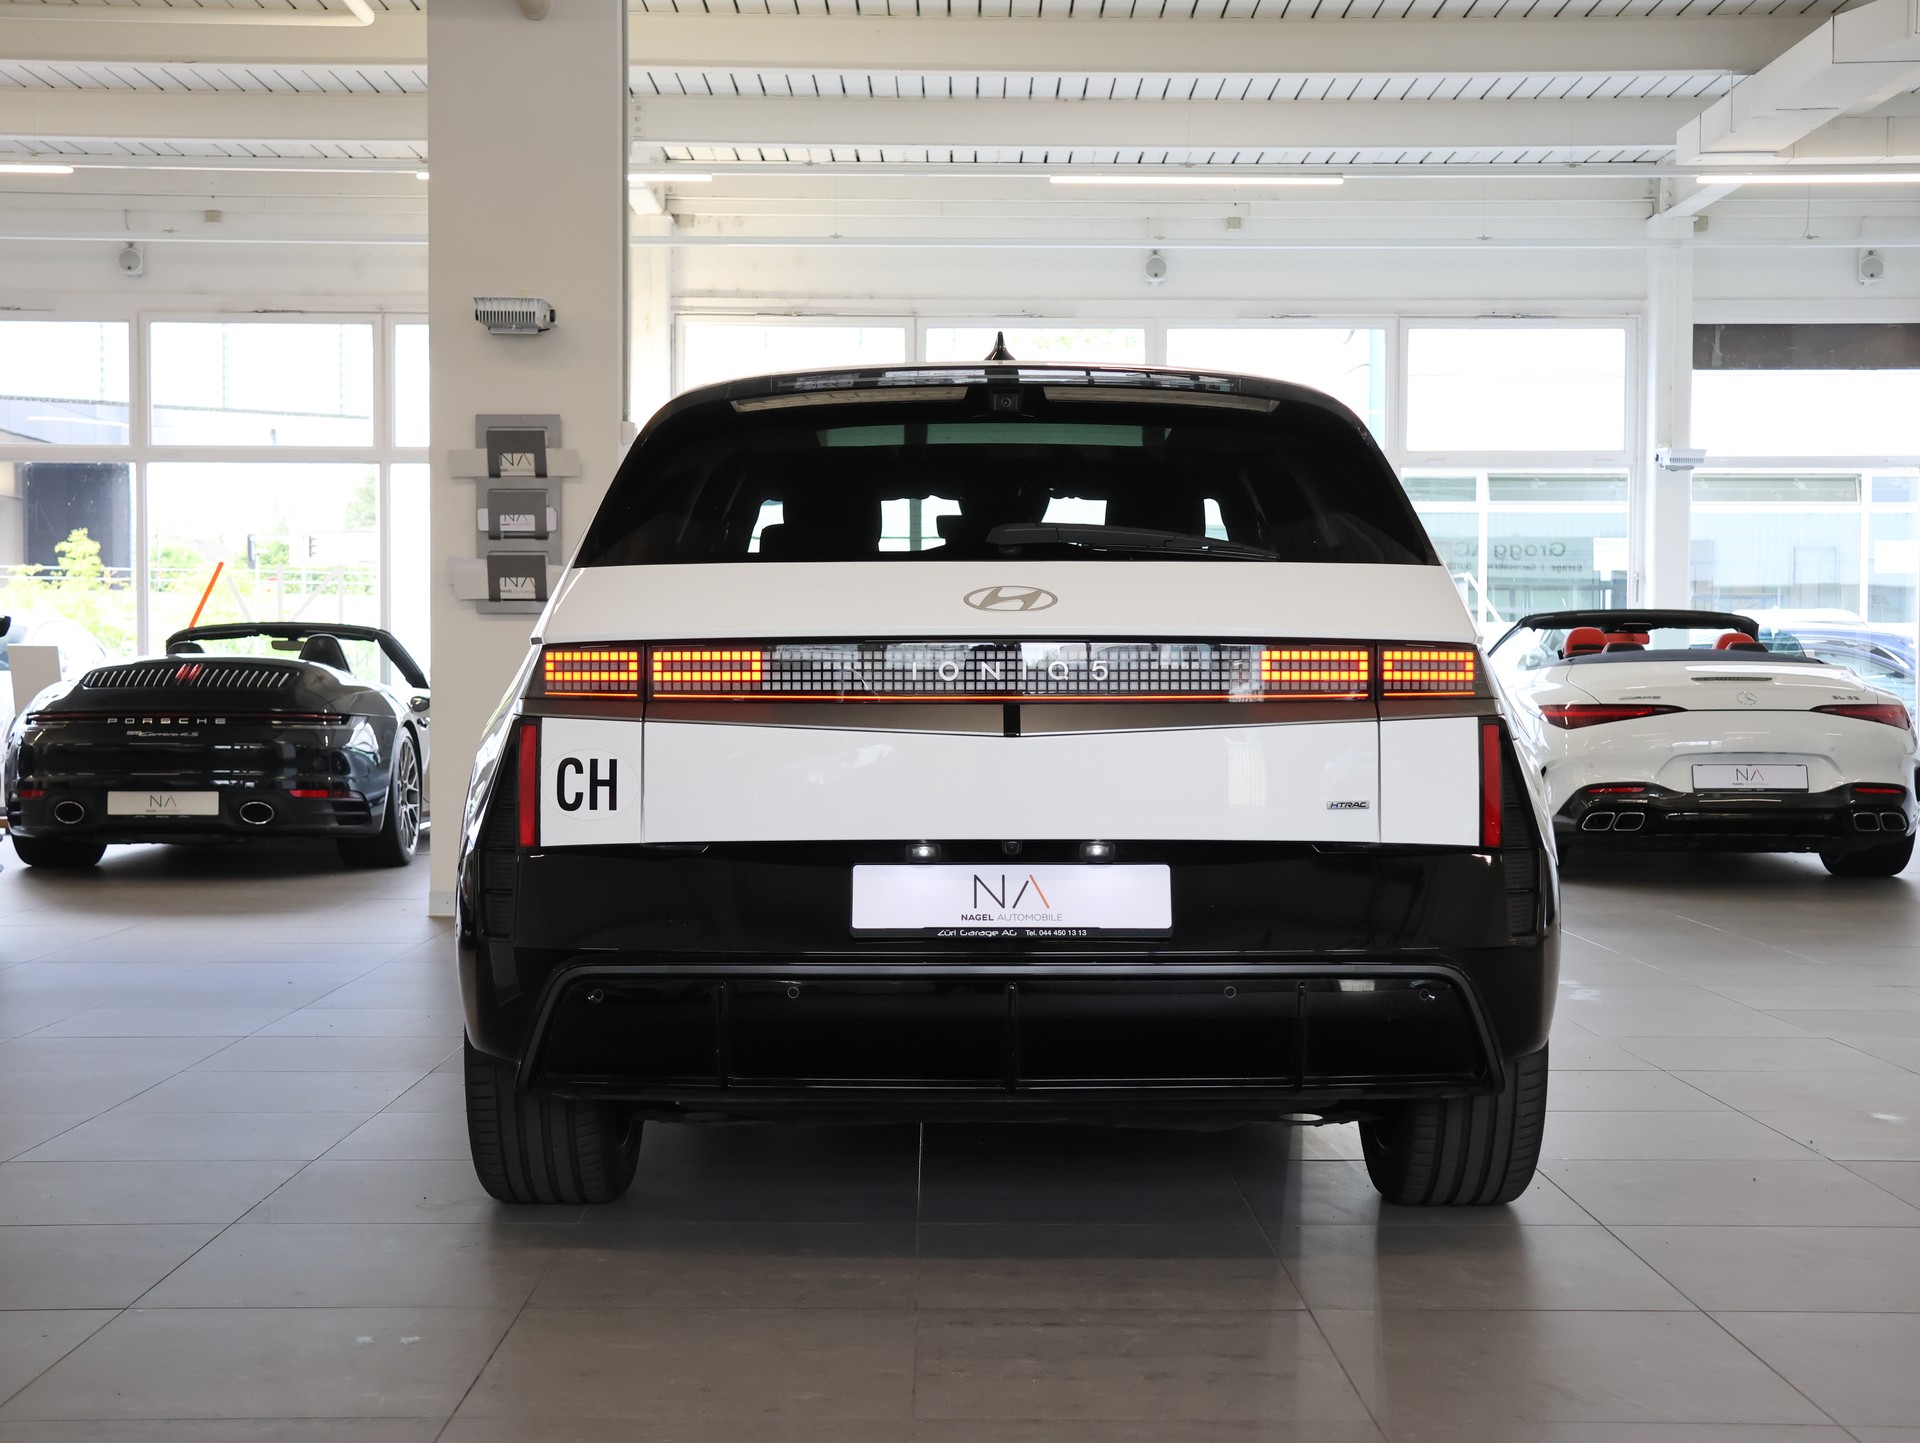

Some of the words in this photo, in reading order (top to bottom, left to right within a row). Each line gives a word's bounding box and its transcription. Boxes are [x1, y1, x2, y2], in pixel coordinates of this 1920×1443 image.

[1735, 768, 1765, 781] NA
[556, 757, 618, 812] CH
[150, 795, 177, 808] NA
[973, 874, 1050, 909] NA
[996, 913, 1063, 921] AUTOMOBILE
[959, 929, 999, 937] Garage
